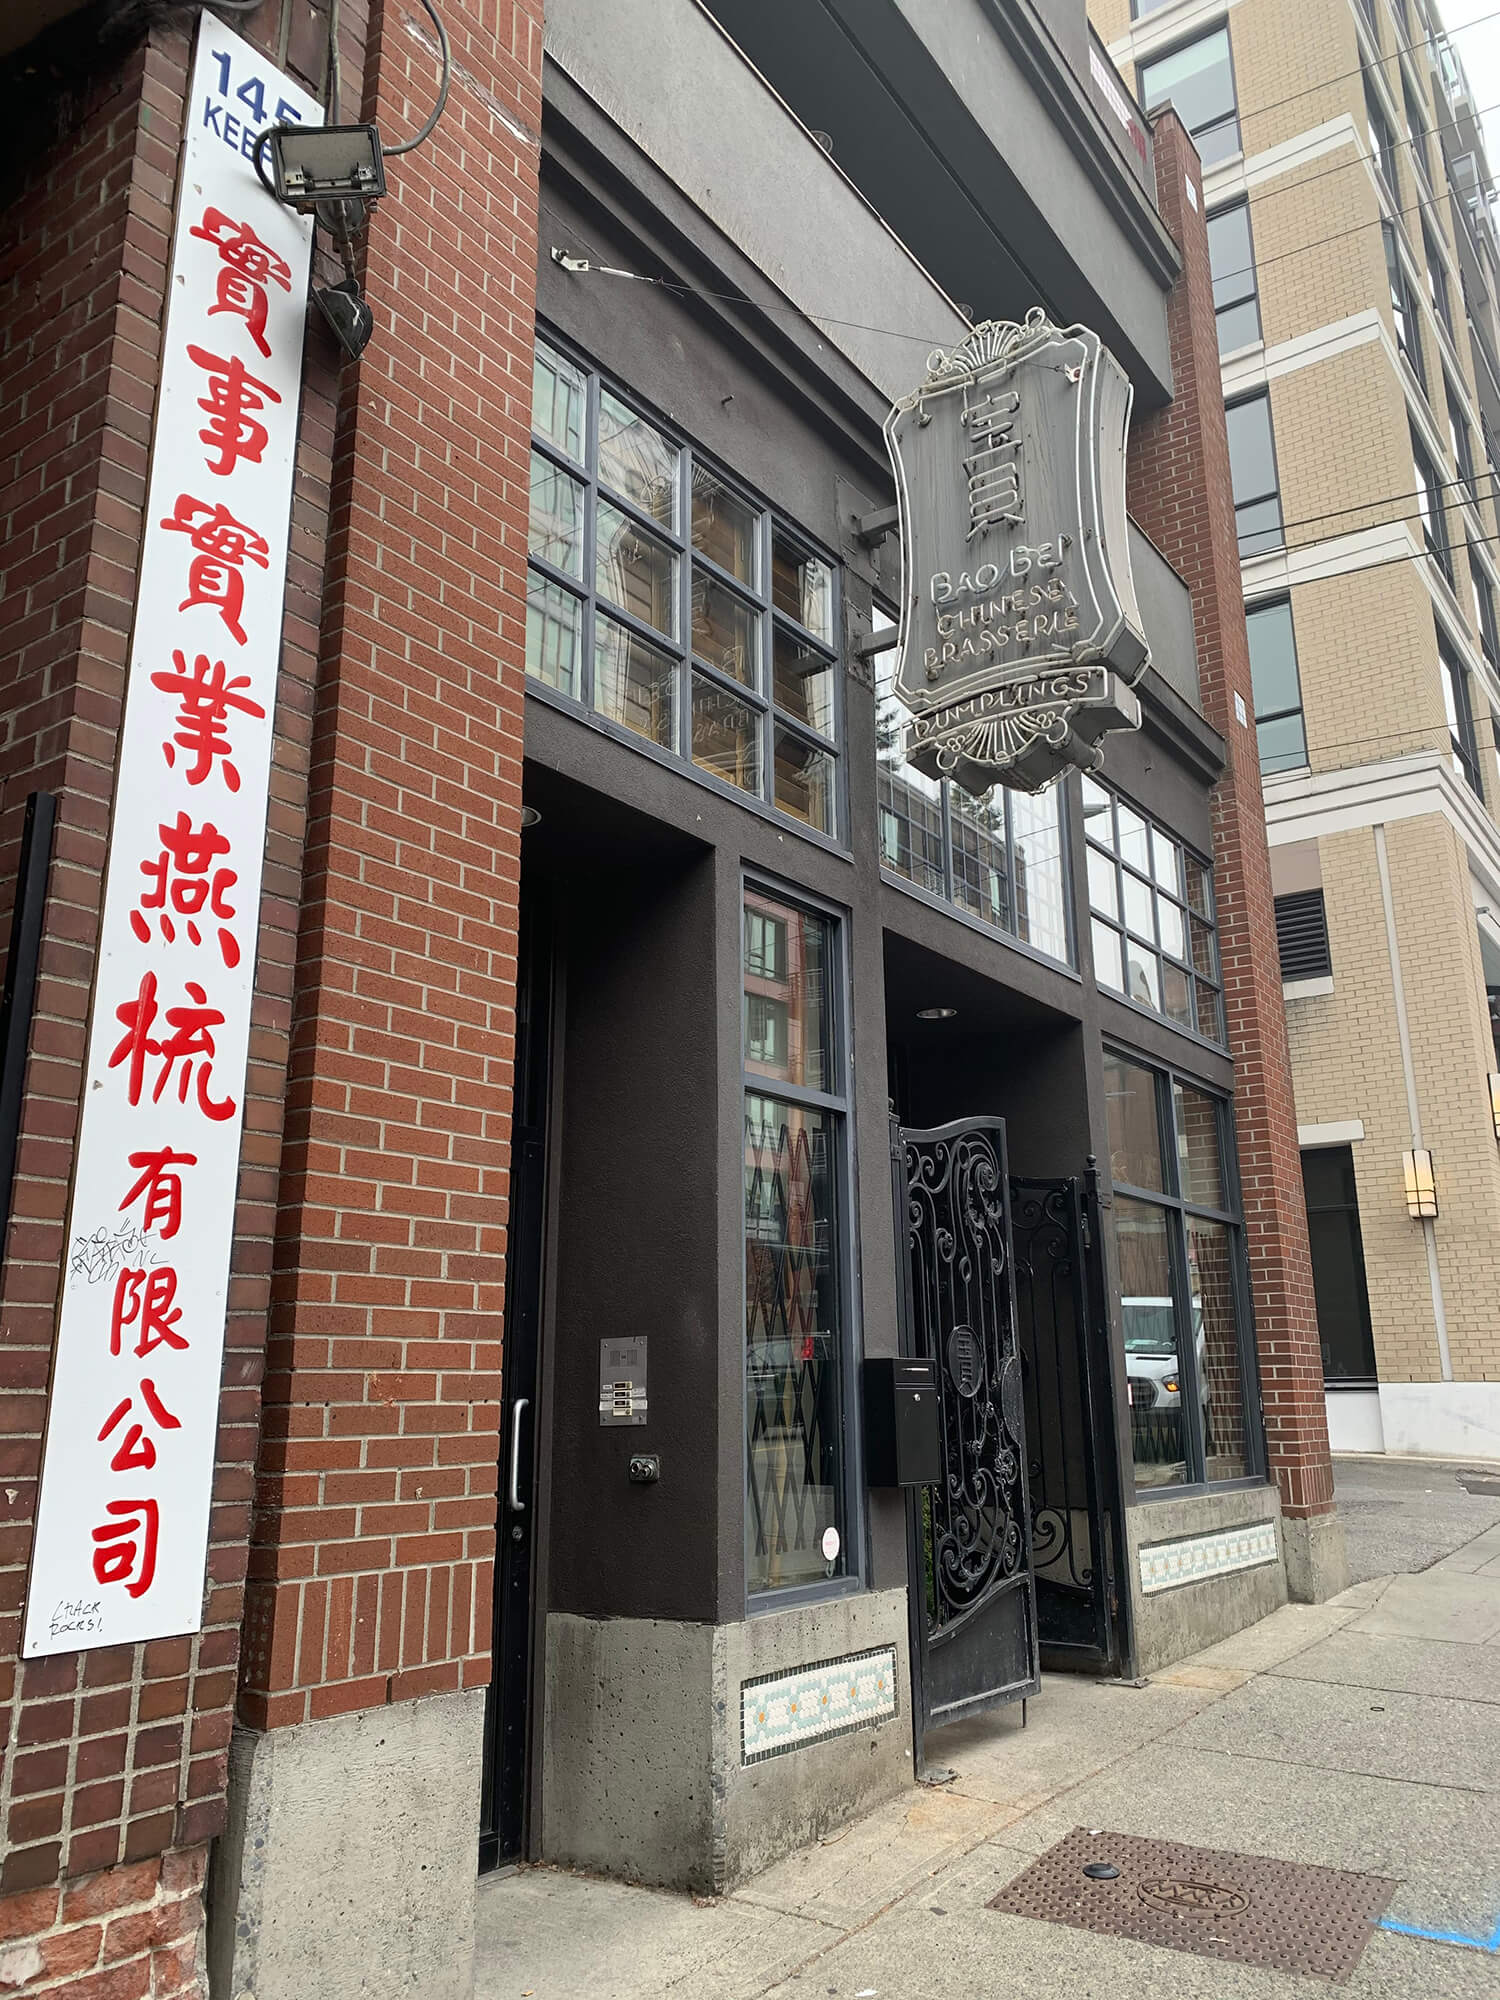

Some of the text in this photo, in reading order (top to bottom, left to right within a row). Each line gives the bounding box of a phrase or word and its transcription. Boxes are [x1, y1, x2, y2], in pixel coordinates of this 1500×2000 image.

[930, 534, 1064, 604] BAO BEI
[923, 606, 1080, 669] BRASSERIE
[937, 577, 1066, 638] CHINESE
[915, 671, 1091, 740] DUMPLINGS
